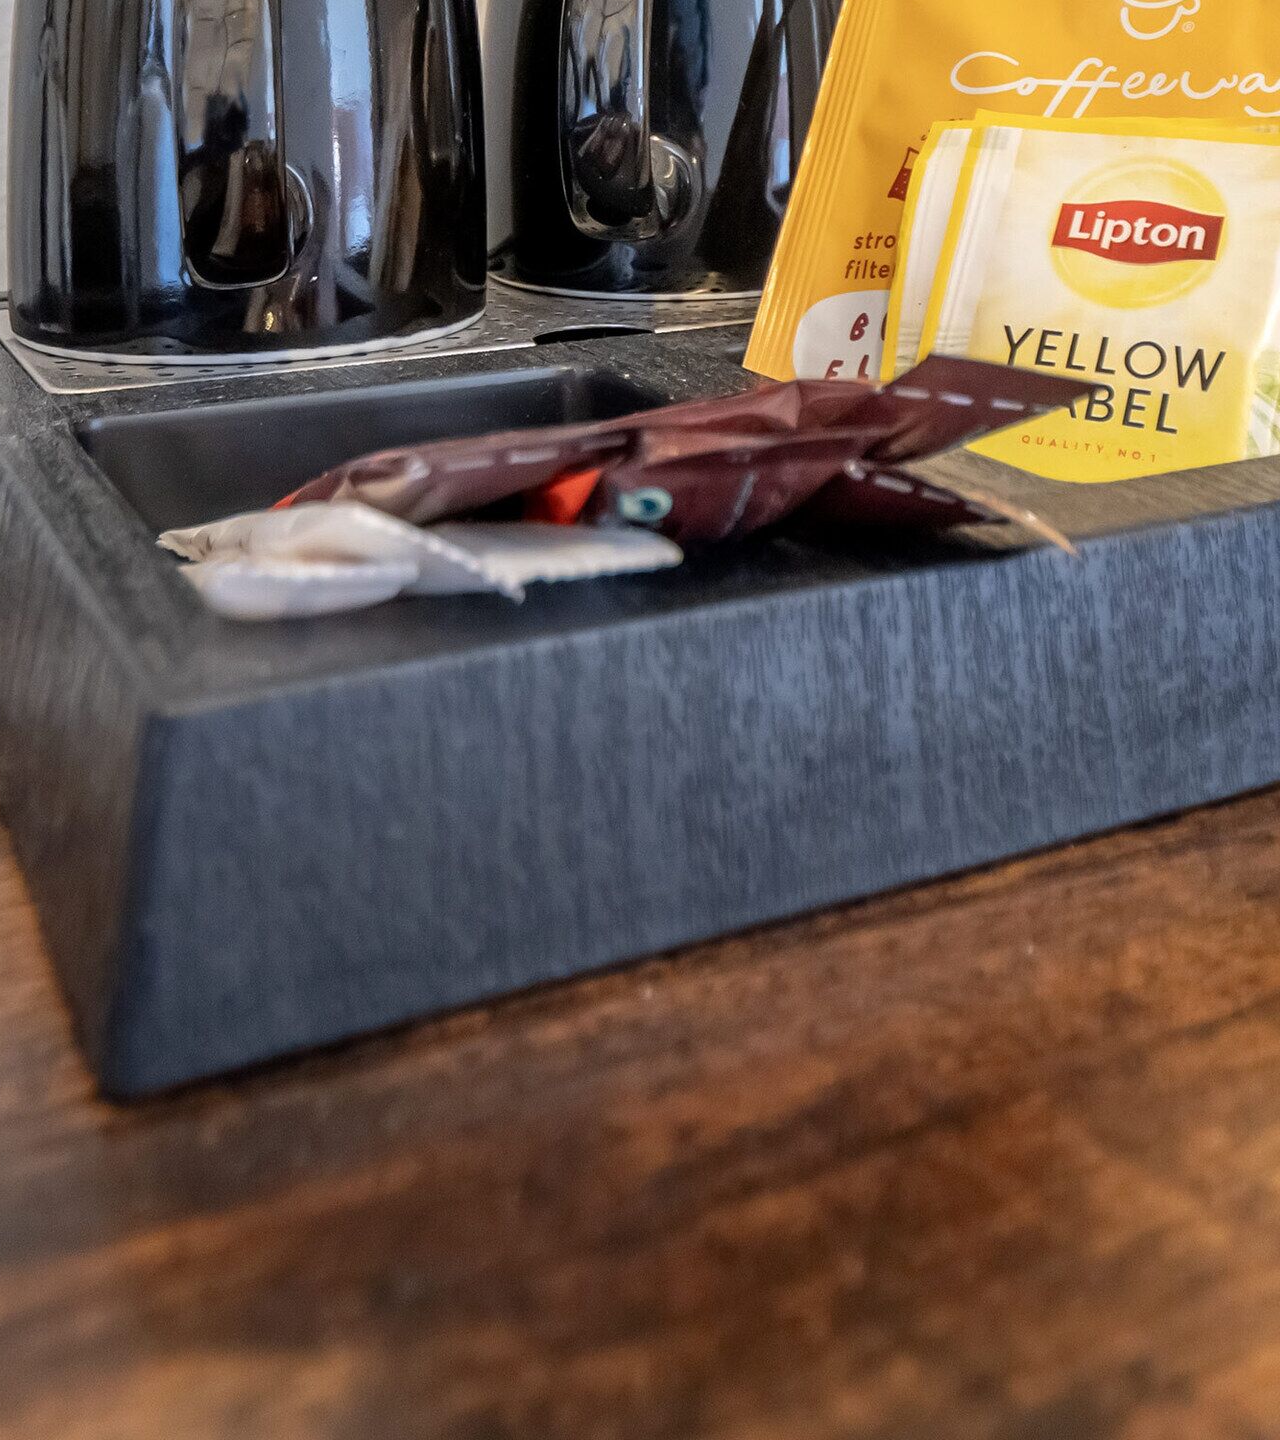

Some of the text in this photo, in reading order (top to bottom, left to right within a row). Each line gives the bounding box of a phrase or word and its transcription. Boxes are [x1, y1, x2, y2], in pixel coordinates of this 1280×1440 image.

[853, 231, 896, 250] stro
[1068, 210, 1206, 250] Lipton
[1004, 325, 1227, 392] YELLOW
[1068, 383, 1179, 435] BEL
[1021, 434, 1105, 455] QUALITY
